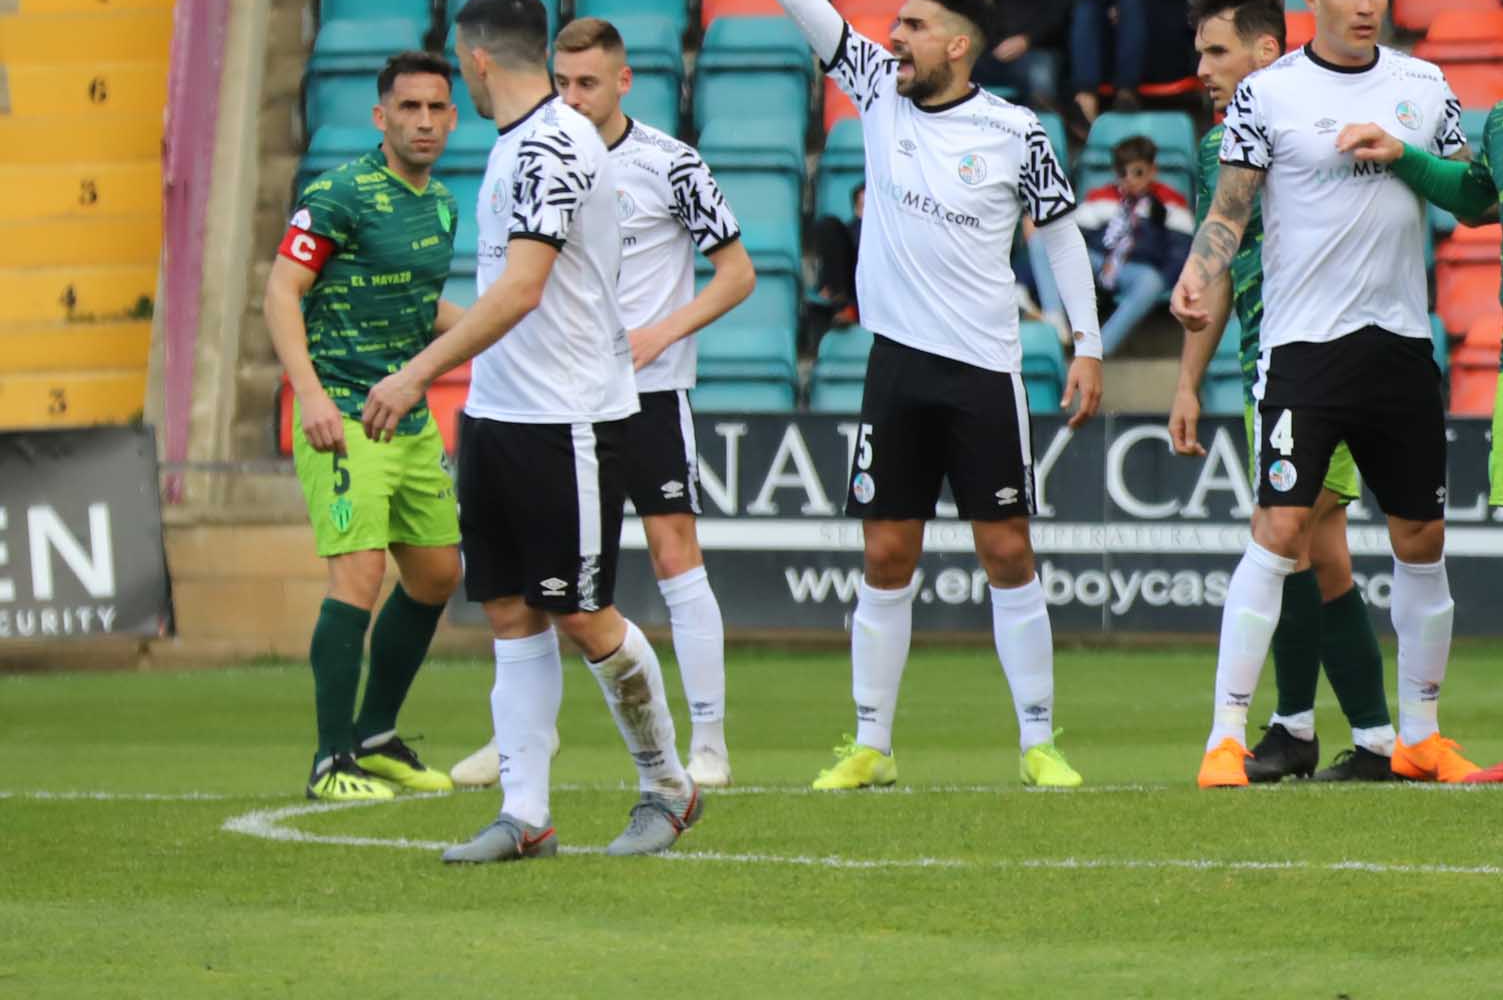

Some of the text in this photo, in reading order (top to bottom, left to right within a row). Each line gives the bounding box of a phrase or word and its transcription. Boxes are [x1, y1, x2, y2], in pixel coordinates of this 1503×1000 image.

[88, 76, 107, 103] 6
[290, 233, 317, 262] C
[60, 283, 77, 312] 4
[48, 388, 67, 415] 3
[857, 423, 874, 471] 5
[1268, 408, 1295, 457] 4
[331, 450, 352, 496] 5
